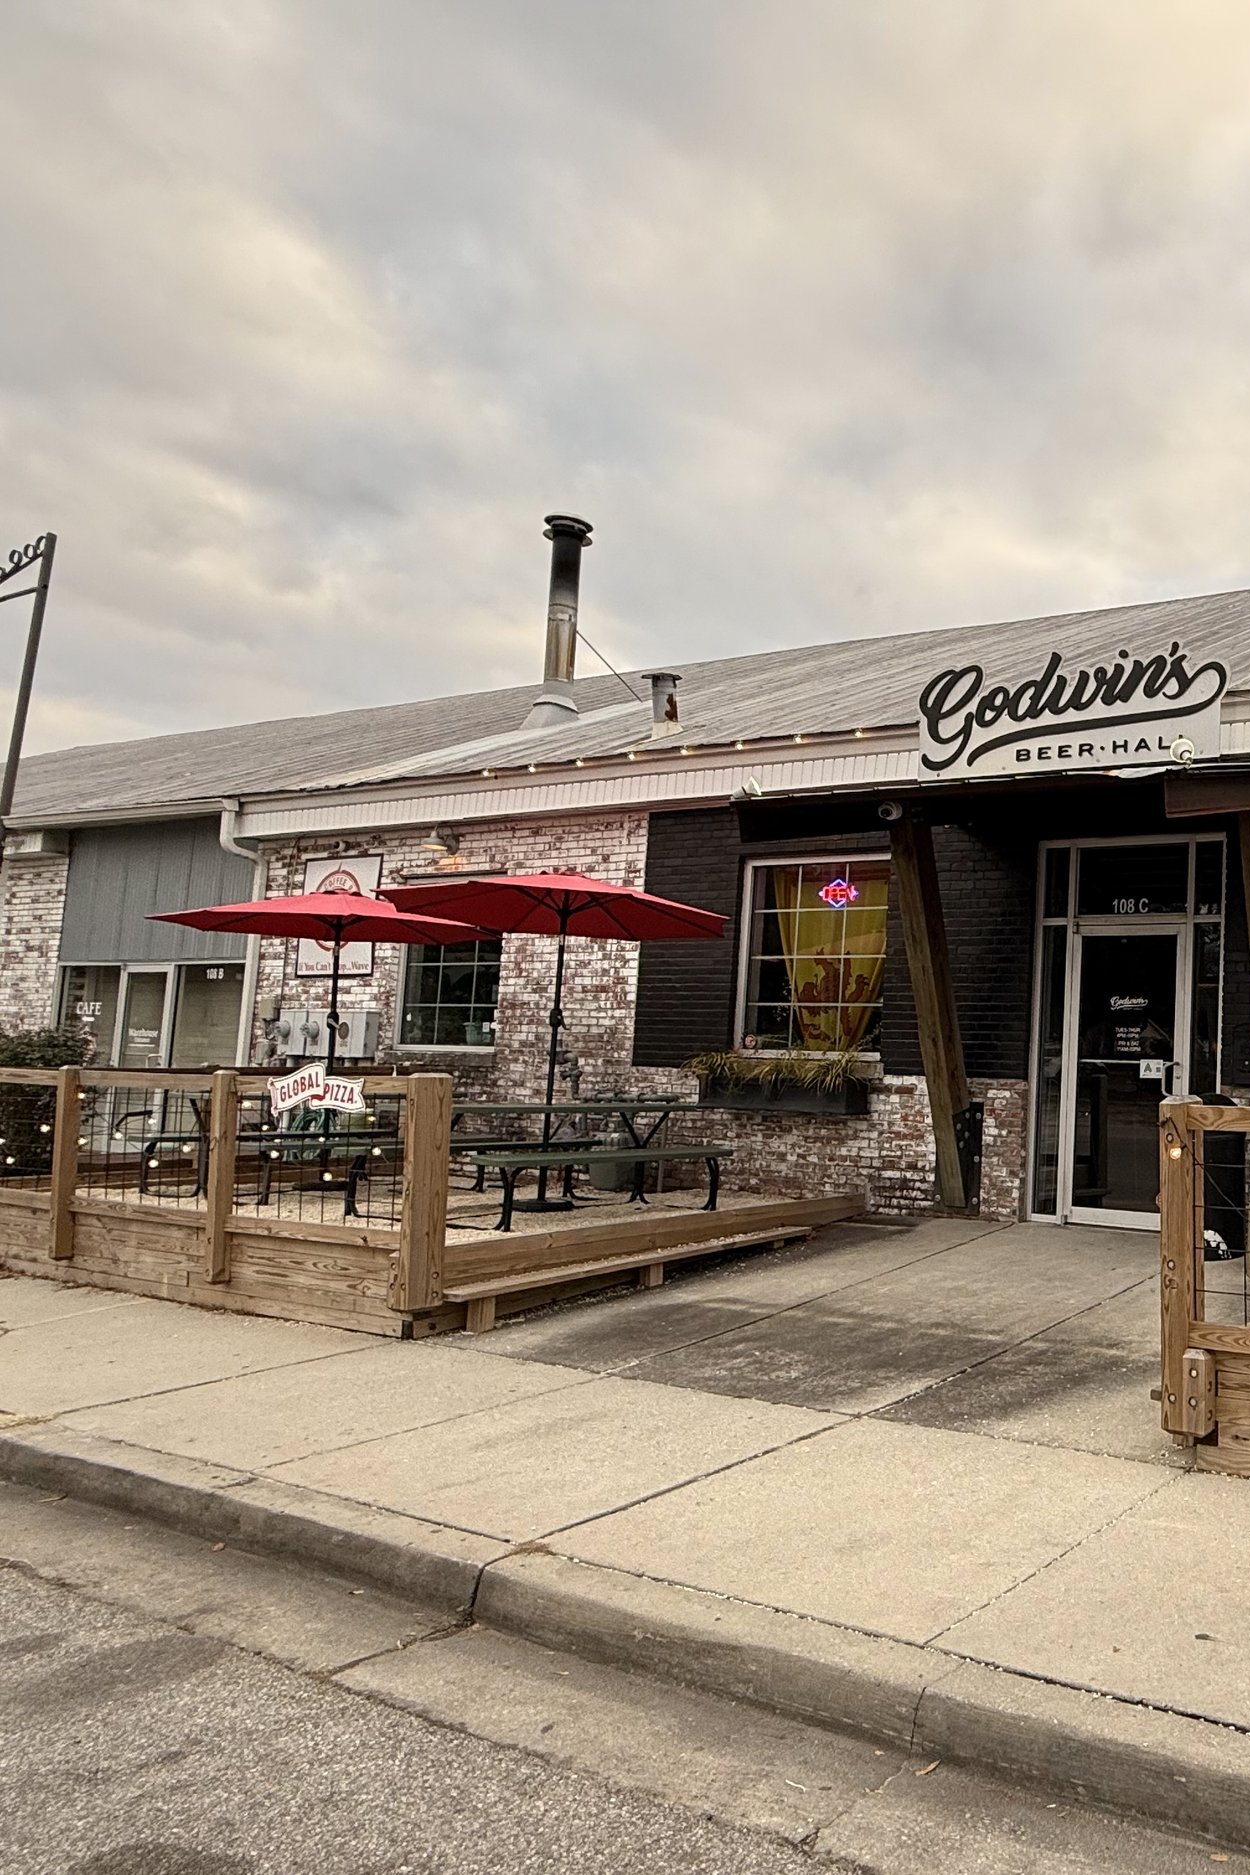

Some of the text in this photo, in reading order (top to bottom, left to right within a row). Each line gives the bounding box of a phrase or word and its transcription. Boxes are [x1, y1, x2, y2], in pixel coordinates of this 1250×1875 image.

[919, 641, 1227, 771] Godwin's
[822, 884, 857, 902] OPEN
[1112, 897, 1149, 914] 108 C
[76, 1002, 102, 1015] CAFE
[280, 1071, 321, 1103] GLOBAL
